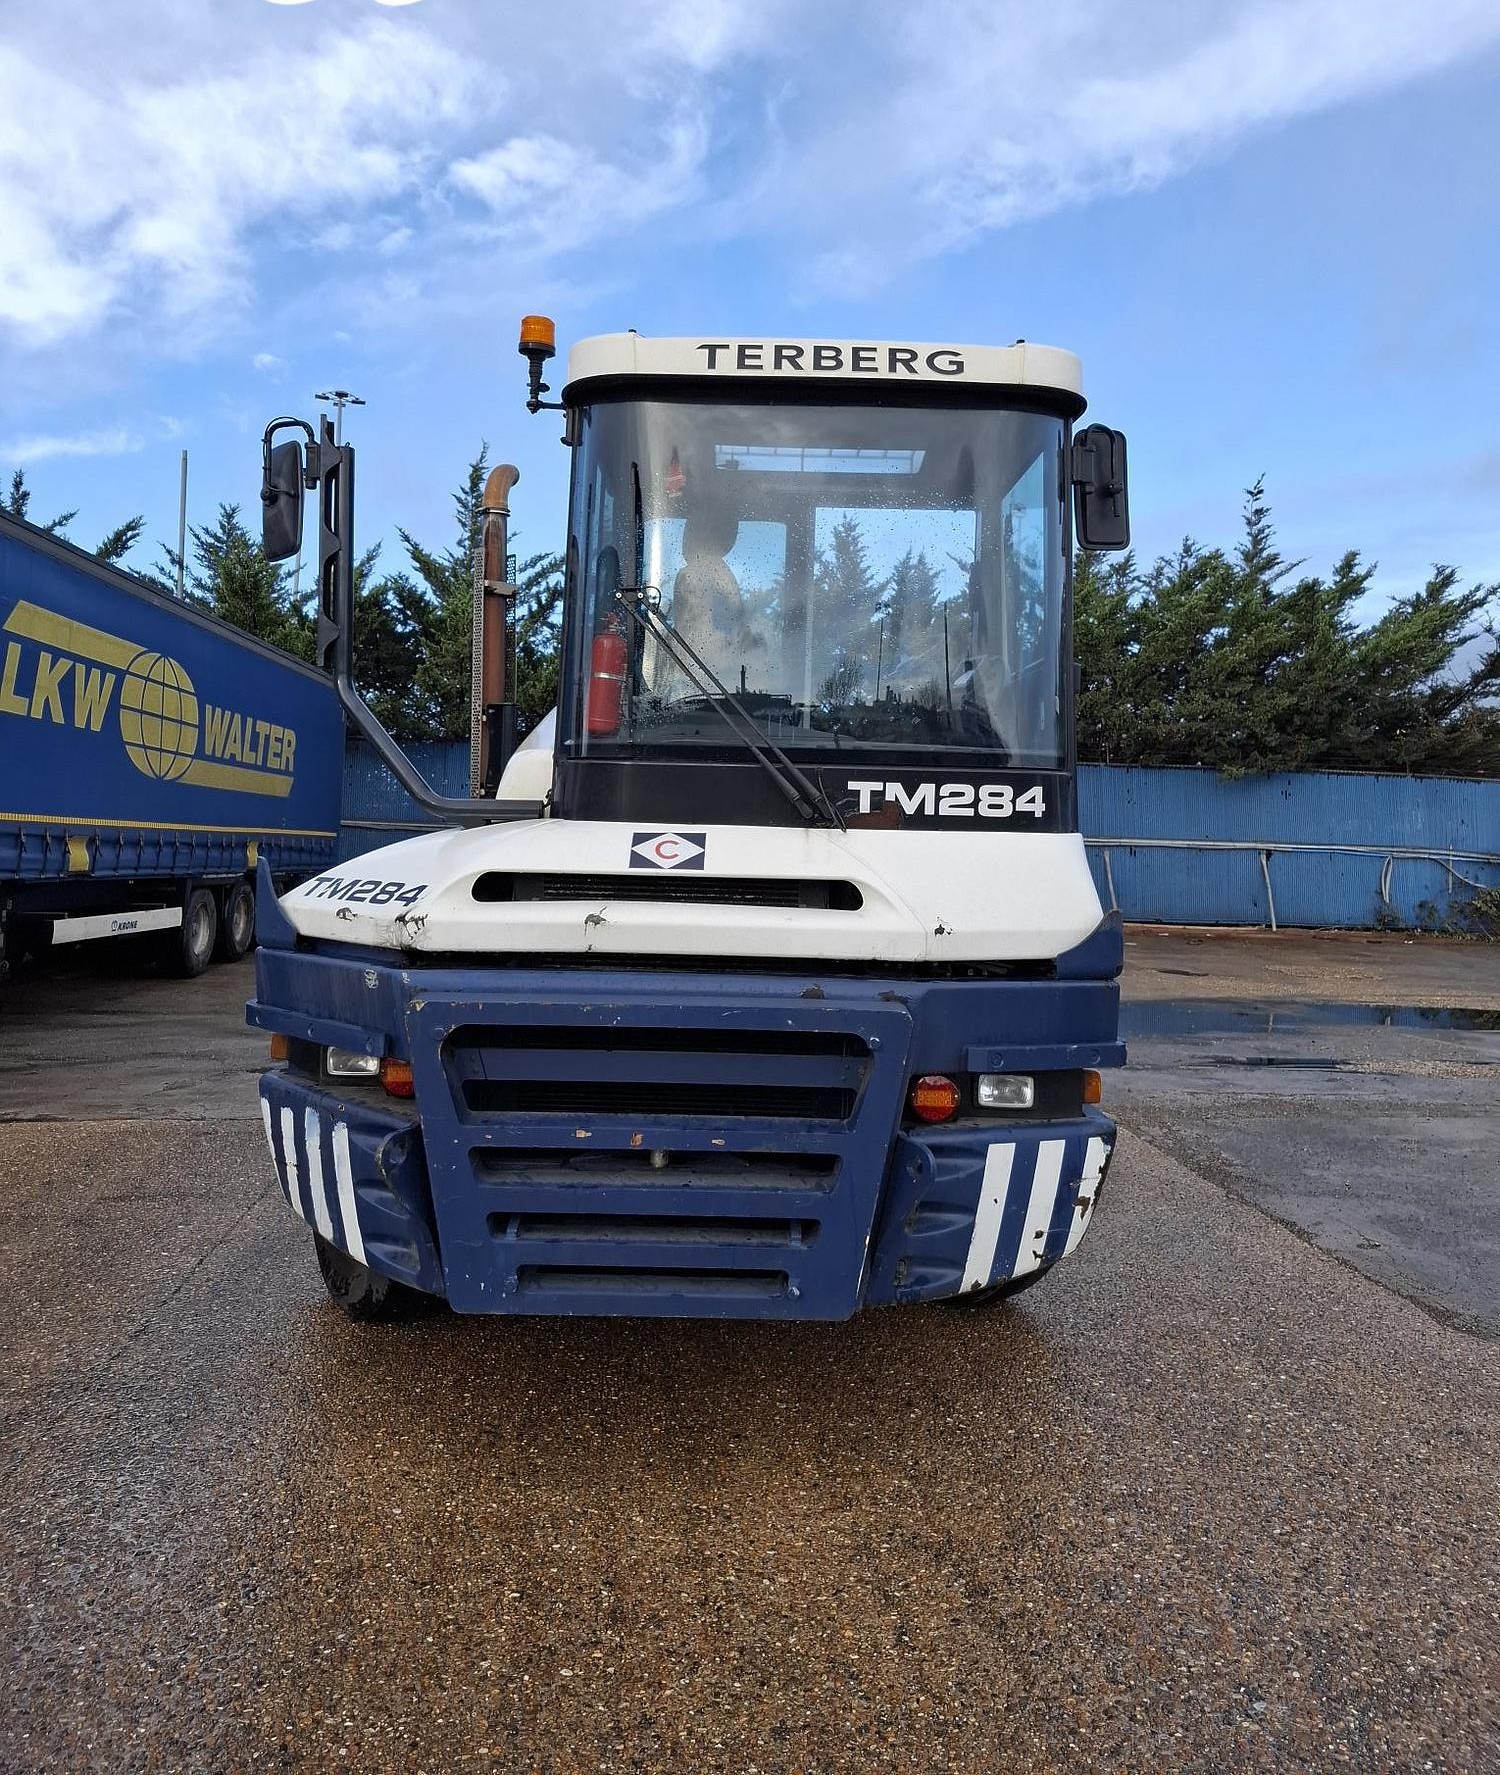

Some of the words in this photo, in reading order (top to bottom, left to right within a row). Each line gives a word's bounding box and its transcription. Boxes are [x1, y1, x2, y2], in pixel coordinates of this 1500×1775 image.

[696, 344, 965, 375] TERBERG
[0, 641, 116, 732] LKW
[205, 704, 297, 773] WALTER
[847, 781, 1046, 818] TM284
[654, 840, 680, 860] C
[304, 876, 428, 907] TM284
